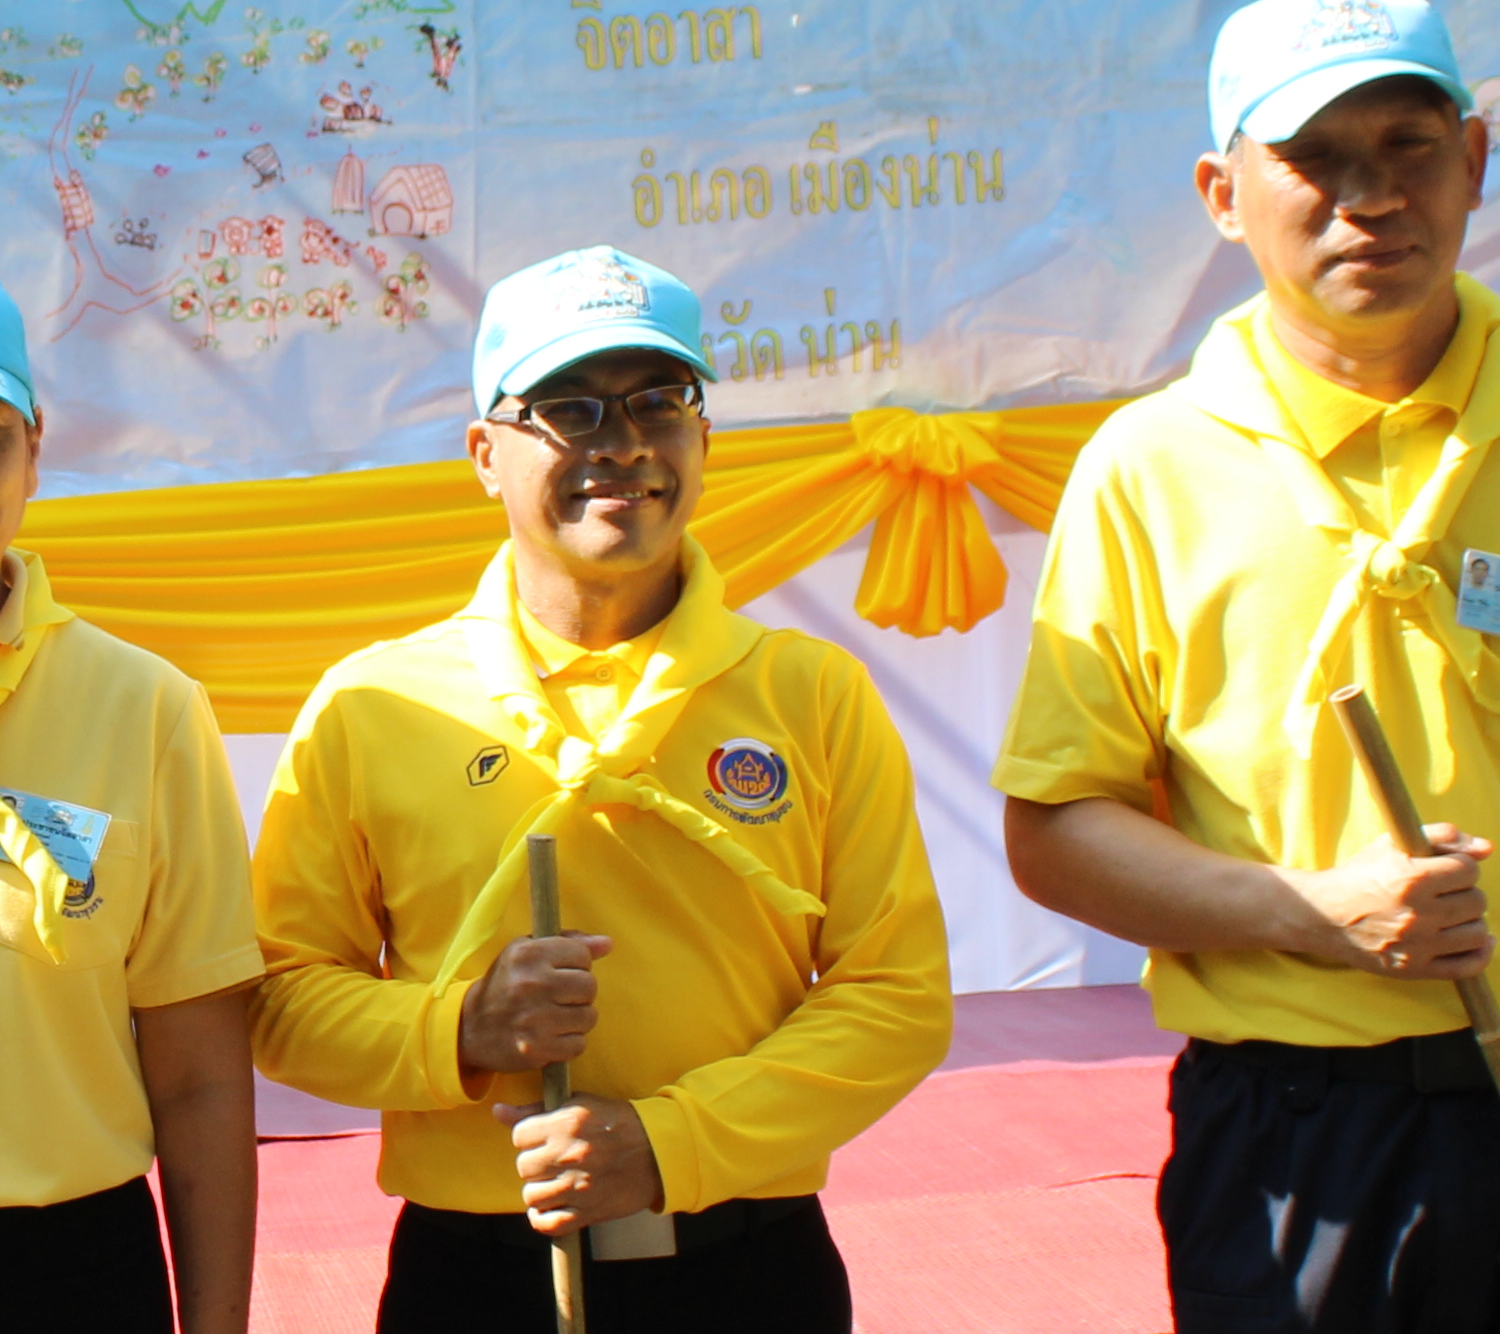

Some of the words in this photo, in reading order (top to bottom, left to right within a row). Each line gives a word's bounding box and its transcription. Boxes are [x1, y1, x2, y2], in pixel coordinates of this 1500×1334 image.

[630, 147, 775, 230] อำเภอ
[789, 115, 1006, 222] เมืองน่าน
[798, 285, 901, 379] น่าน
